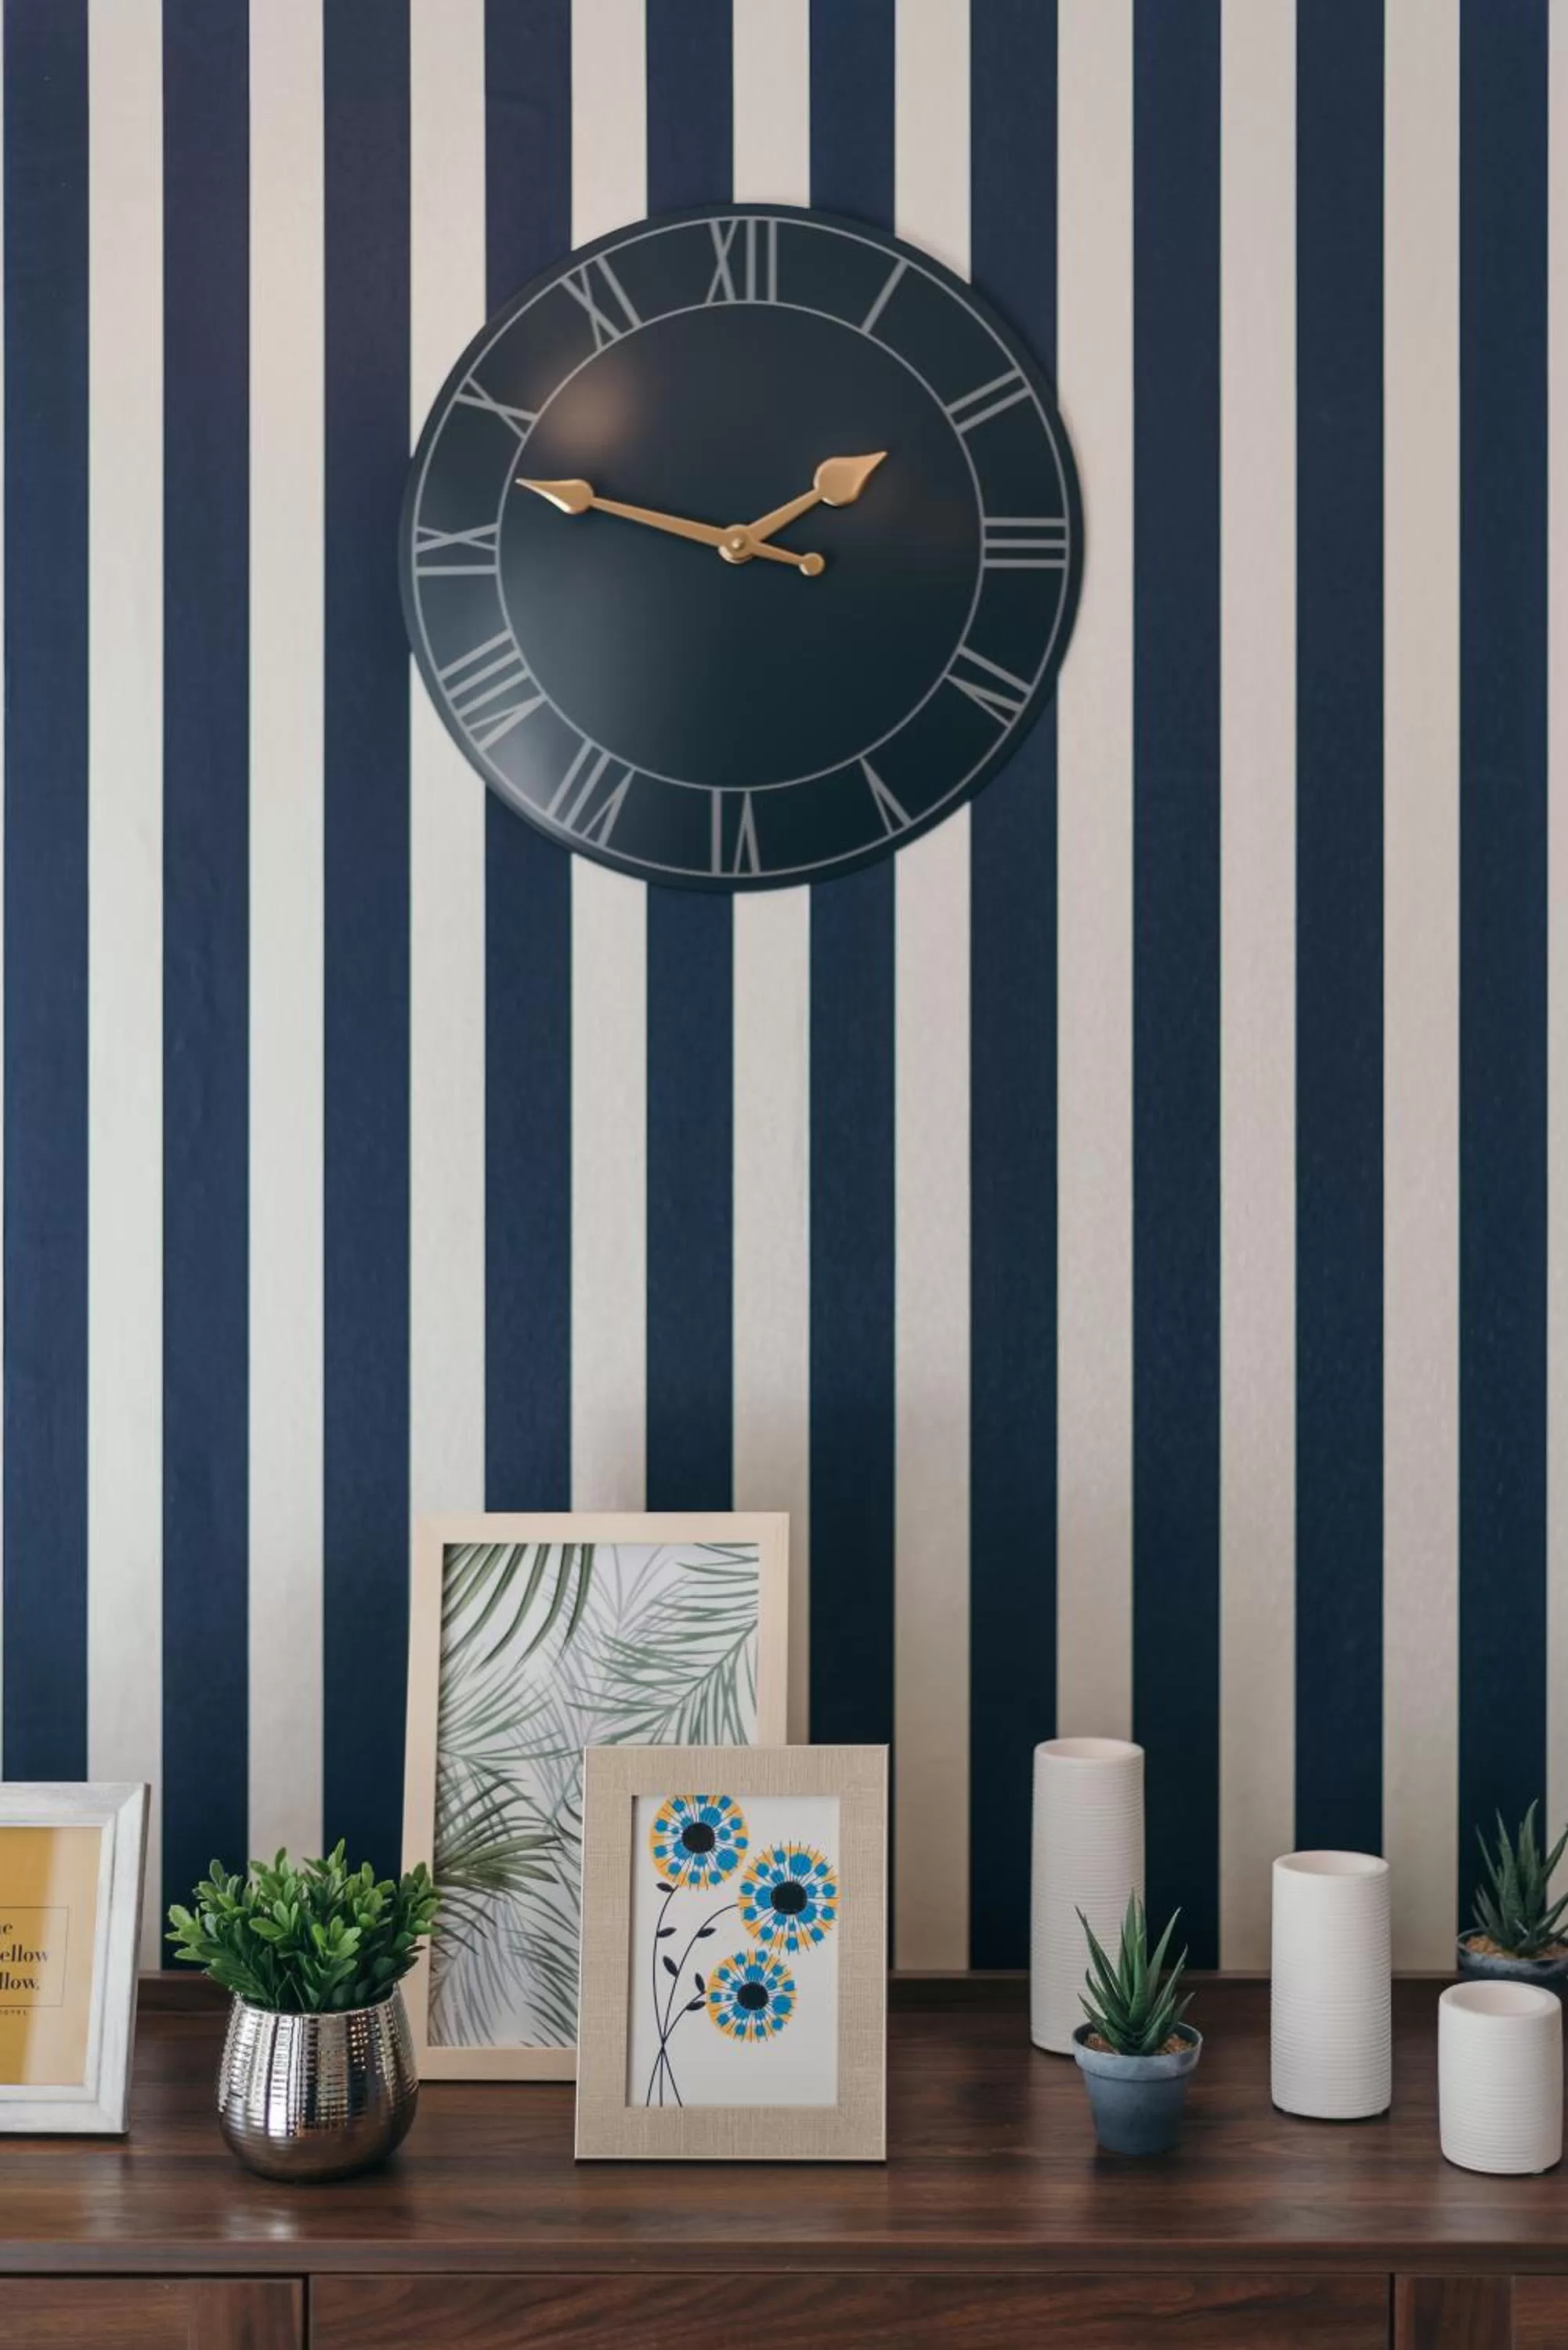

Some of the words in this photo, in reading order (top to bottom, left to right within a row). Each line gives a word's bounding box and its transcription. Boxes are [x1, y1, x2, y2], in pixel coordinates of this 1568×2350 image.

[705, 219, 776, 303] XII
[862, 258, 911, 334] I
[560, 255, 644, 350] XI
[454, 376, 540, 439] X
[944, 368, 1032, 434] II
[414, 523, 498, 576] IX
[983, 517, 1068, 568] III
[438, 630, 547, 750] VIII
[945, 645, 1032, 728] IV
[546, 738, 636, 848] VII
[711, 789, 760, 875] VI
[860, 757, 913, 837] V
